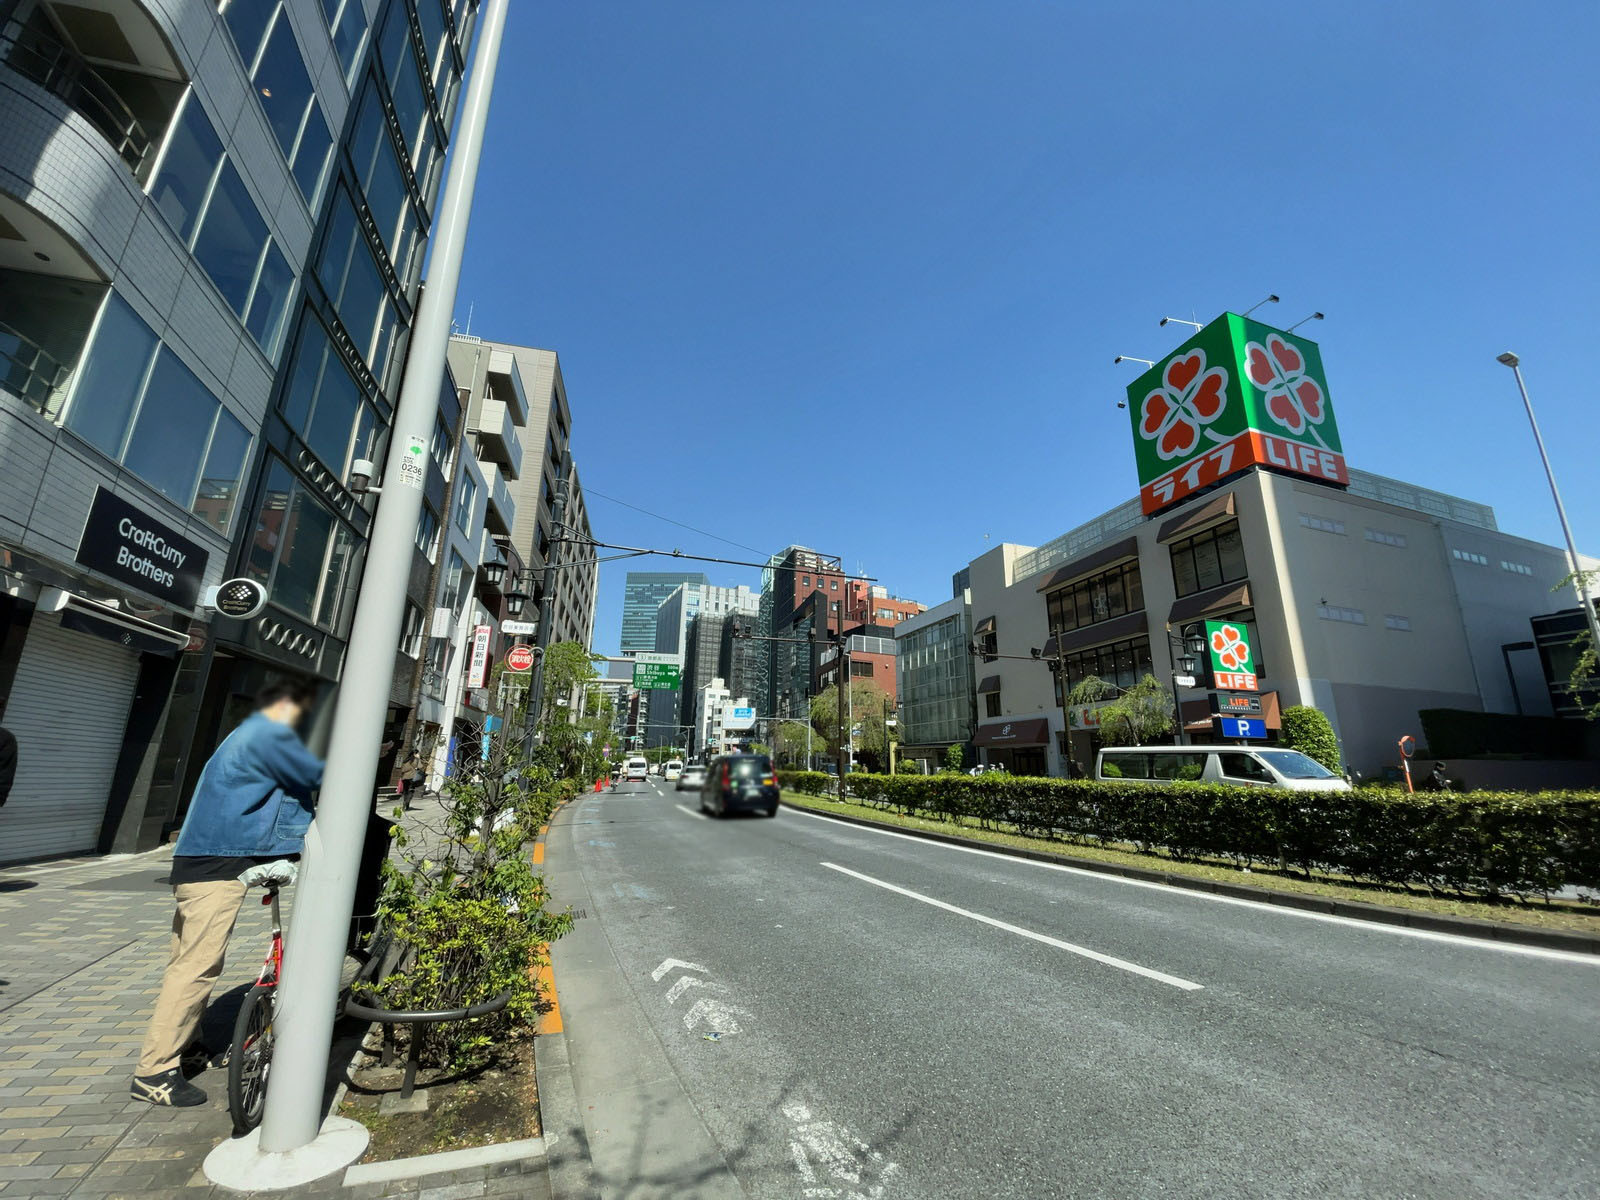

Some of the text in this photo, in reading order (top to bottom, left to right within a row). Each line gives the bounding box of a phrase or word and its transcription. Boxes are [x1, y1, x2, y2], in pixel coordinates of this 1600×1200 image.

[401, 463, 422, 476] 0236
[1153, 443, 1235, 503] ライフ
[1264, 437, 1338, 480] LIFE
[119, 518, 186, 568] CraftCurry
[117, 546, 174, 587] Brothers
[473, 635, 487, 667] 朝日新聞
[1216, 674, 1256, 689] LIFE
[1229, 697, 1249, 707] LIFE
[1237, 720, 1251, 736] P
